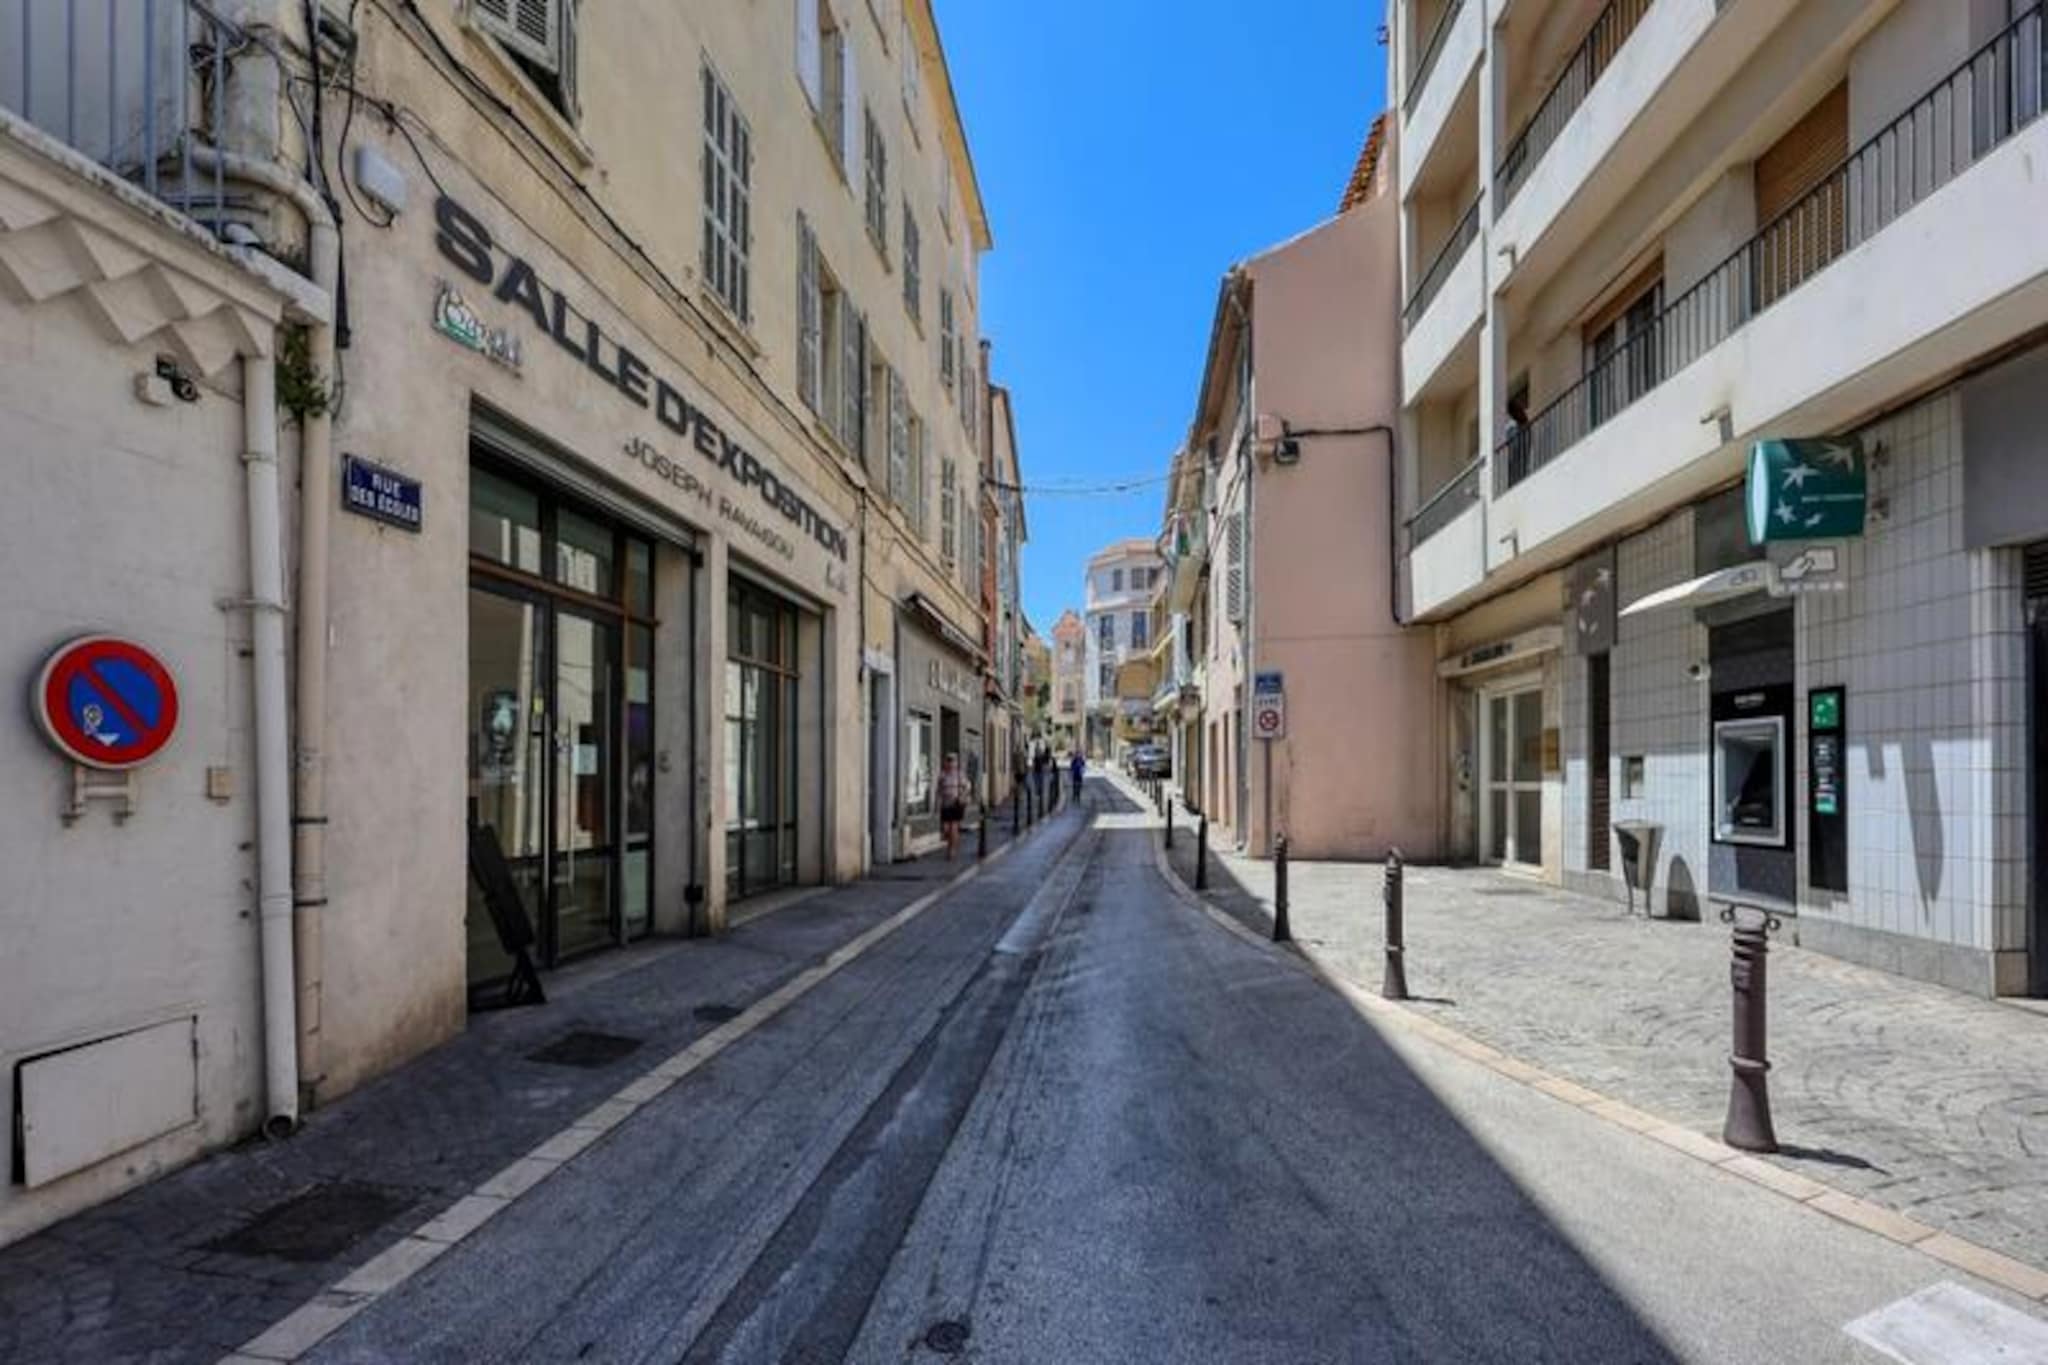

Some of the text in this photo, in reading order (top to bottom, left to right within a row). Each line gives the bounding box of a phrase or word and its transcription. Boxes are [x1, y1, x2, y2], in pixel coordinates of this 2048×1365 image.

[434, 195, 650, 408] SALLE
[655, 376, 848, 563] D'EXPOSITION
[372, 473, 402, 500] RUE
[622, 436, 713, 507] JOSEPH
